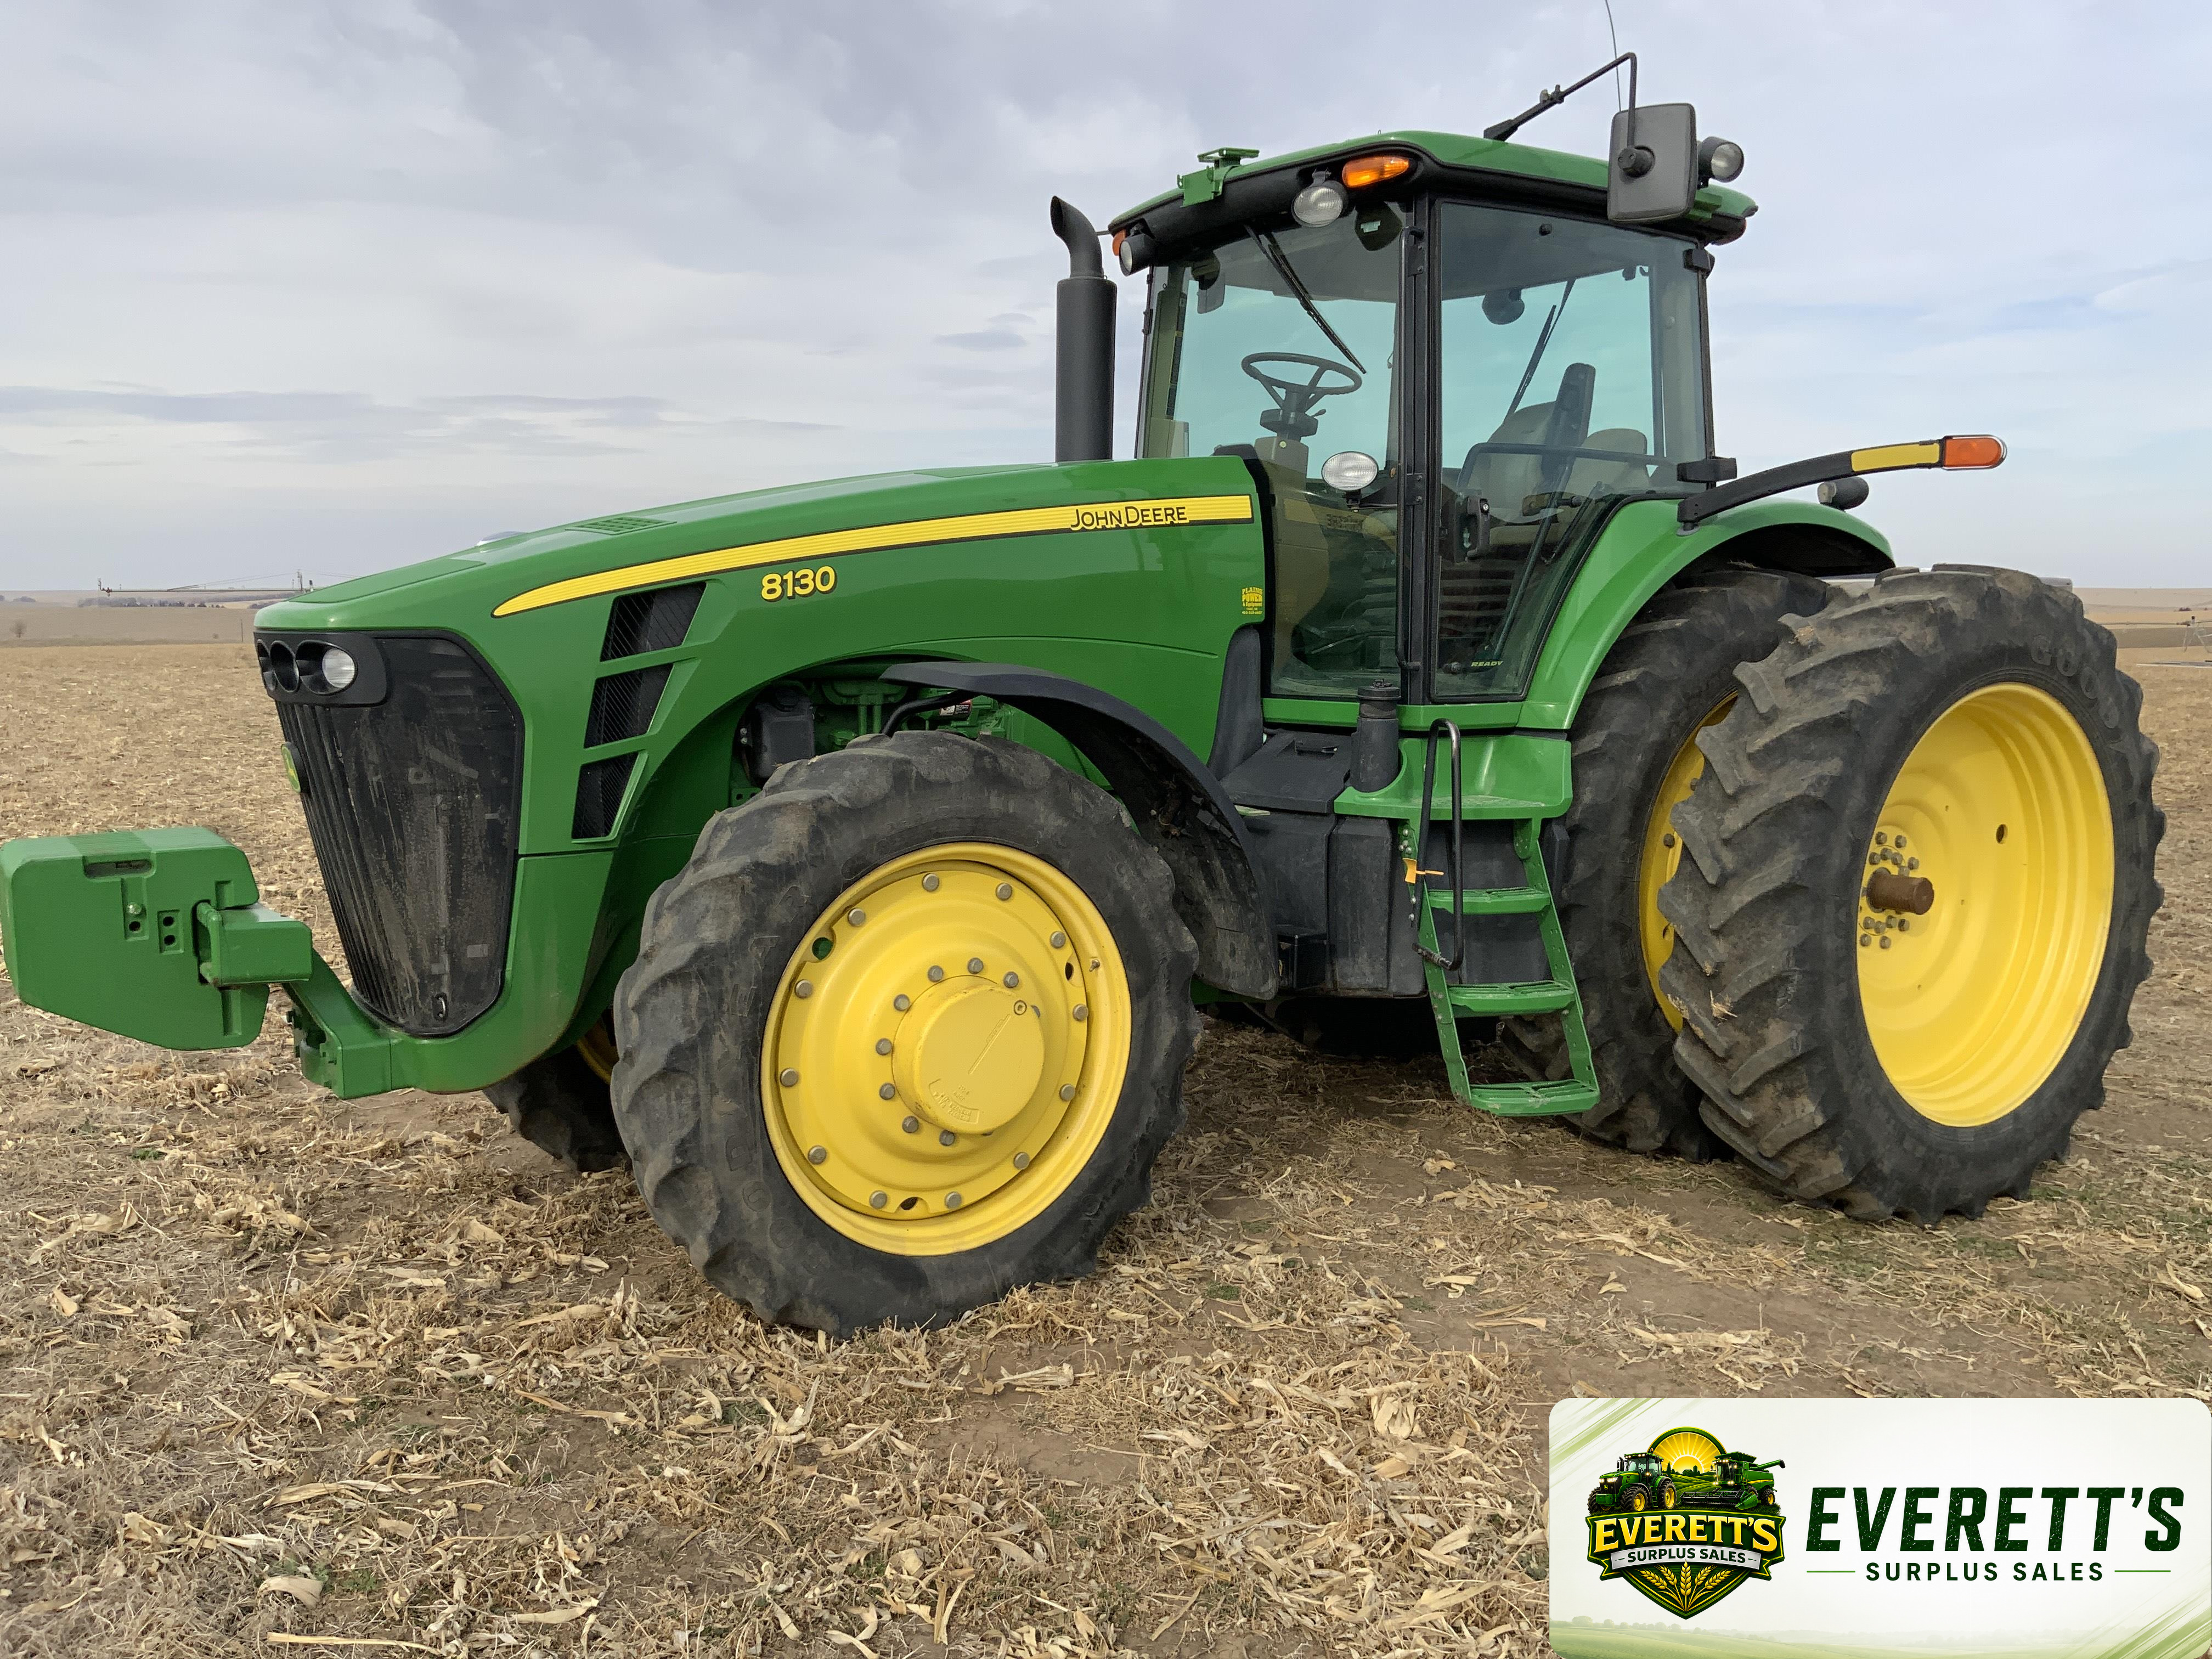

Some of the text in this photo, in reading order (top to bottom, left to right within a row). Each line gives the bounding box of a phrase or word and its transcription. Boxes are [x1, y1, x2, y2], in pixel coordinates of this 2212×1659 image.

[1070, 506, 1188, 529] JOHN DEERE
[761, 566, 837, 601] 8130
[1242, 586, 1263, 595] PLAINS
[1242, 593, 1263, 602] POWER
